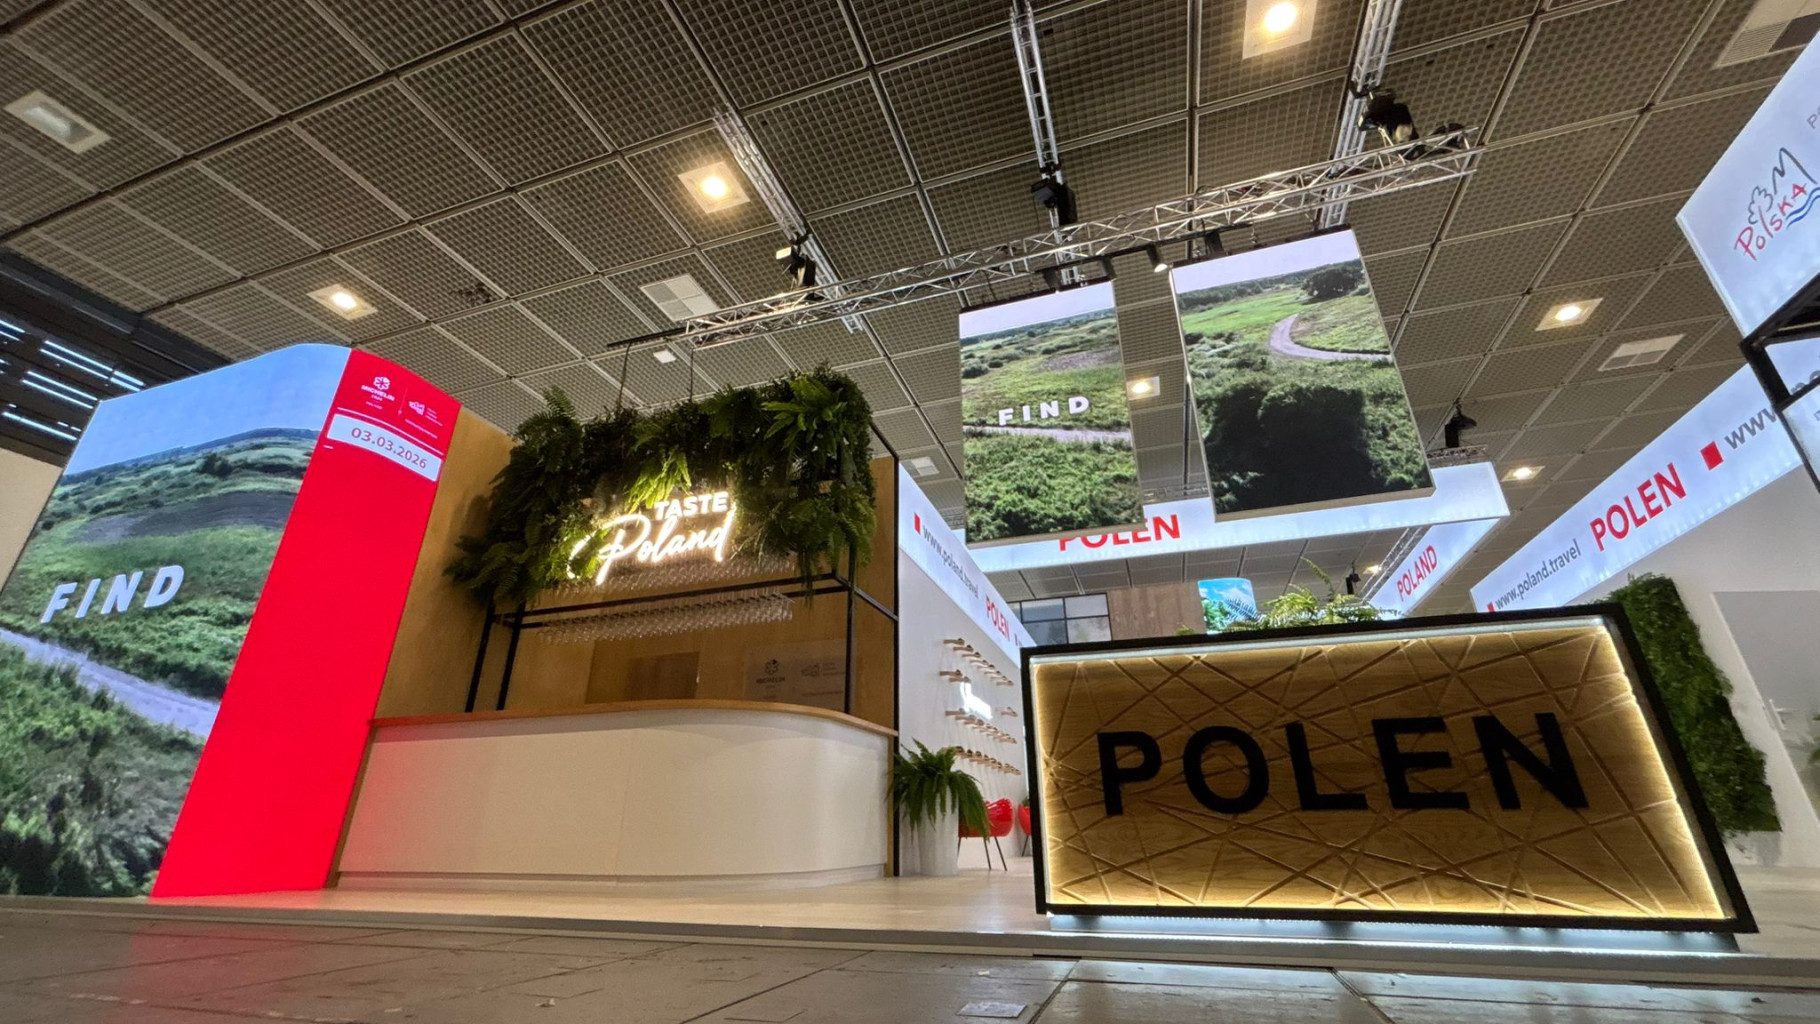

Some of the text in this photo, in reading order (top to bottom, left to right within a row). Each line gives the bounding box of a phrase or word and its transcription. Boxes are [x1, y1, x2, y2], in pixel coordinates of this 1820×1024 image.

[998, 396, 1090, 427] FIND
[351, 427, 427, 469] 03.03.2026
[654, 491, 729, 520] TASTE
[1590, 462, 1687, 552] POLEN
[566, 501, 737, 586] Poland
[923, 525, 979, 599] www.poland.travel
[1397, 545, 1438, 602] POLAND
[40, 564, 185, 624] FIND
[1495, 538, 1582, 610] www.poland.travel
[986, 595, 1011, 642] POLEN
[1097, 711, 1590, 817] POLEN
